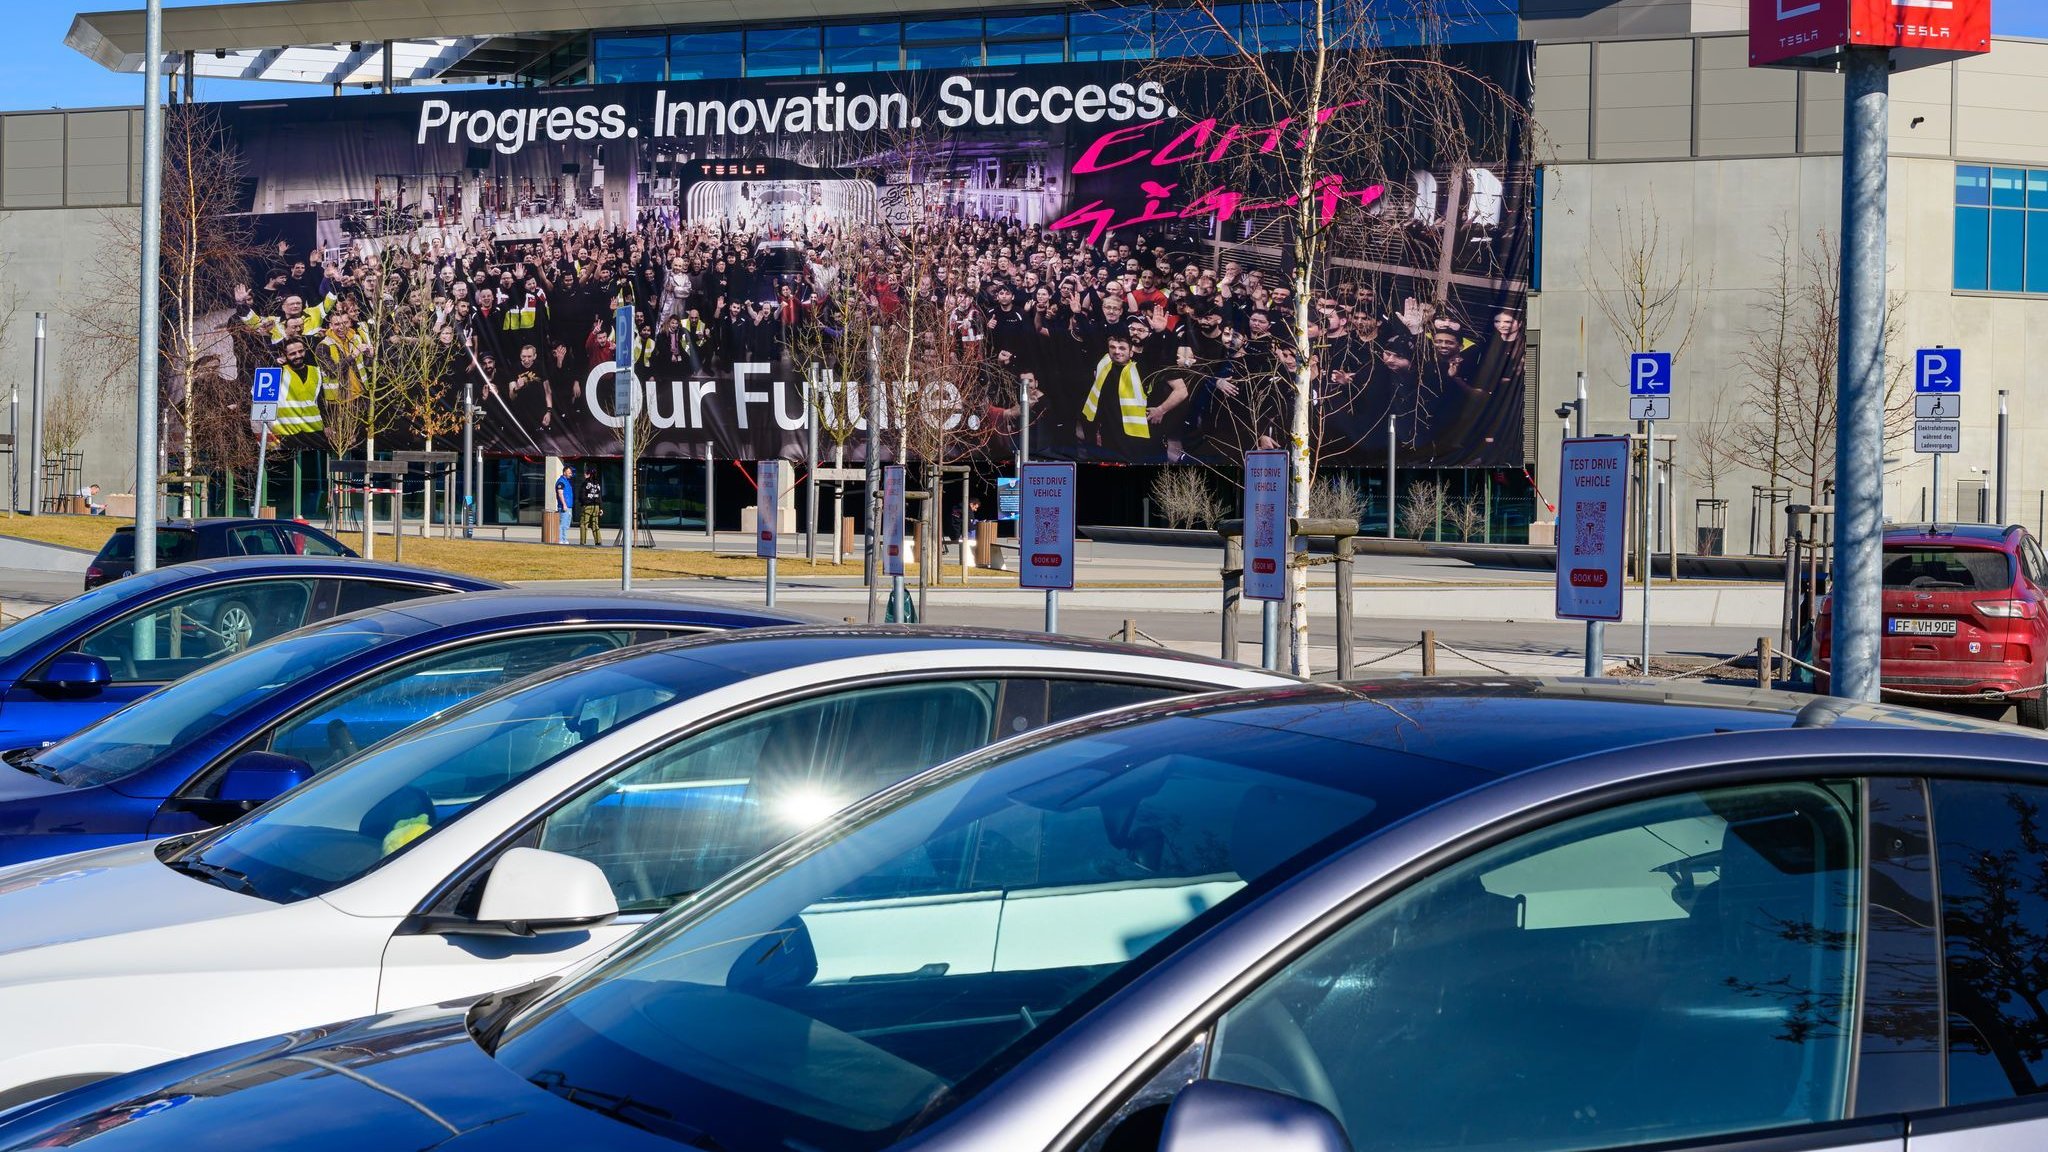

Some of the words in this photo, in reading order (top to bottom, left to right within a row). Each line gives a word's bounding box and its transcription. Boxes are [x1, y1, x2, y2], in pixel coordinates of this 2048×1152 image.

[1895, 24, 1950, 38] TESLA
[1778, 30, 1819, 47] TESLA
[417, 100, 639, 155] Progress.
[653, 81, 922, 138] Innovation.
[938, 75, 1179, 127] Success.
[701, 165, 766, 175] TESLA
[1637, 358, 1658, 389] P
[1923, 354, 1947, 387] P
[257, 372, 273, 397] P
[585, 361, 716, 428] Our
[733, 362, 980, 431] Future.
[1917, 424, 1957, 432] Elektrofahrzeuge
[1920, 442, 1953, 450] Ladevorgangs
[1569, 460, 1589, 471] TEST
[1591, 458, 1617, 470] DRIVE
[1250, 467, 1263, 477] TEST
[1264, 467, 1281, 477] DRIVE
[1028, 476, 1045, 486] TEST
[1046, 476, 1067, 486] DRIVE
[1254, 482, 1277, 492] VEHICLE
[1574, 475, 1611, 487] VEHICLE
[1033, 488, 1062, 498] VEHICLE
[1034, 556, 1050, 564] BOOK
[1051, 556, 1059, 564] ME
[1573, 573, 1592, 583] BOOK
[1593, 574, 1604, 583] ME
[1896, 620, 1910, 631] FF
[1918, 622, 1932, 632] VH
[1935, 622, 1956, 632] 90E
